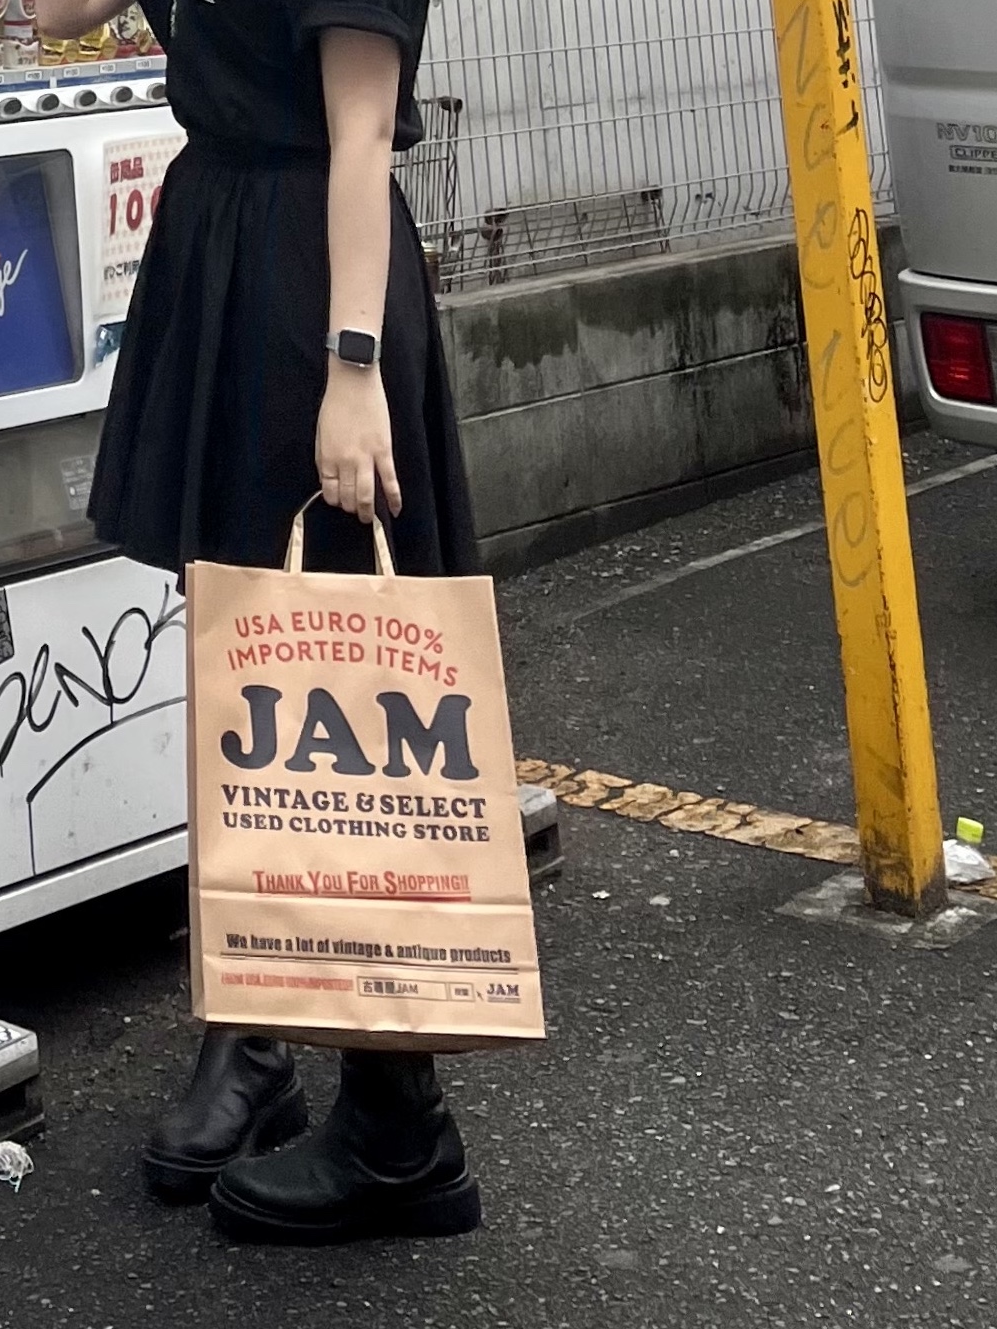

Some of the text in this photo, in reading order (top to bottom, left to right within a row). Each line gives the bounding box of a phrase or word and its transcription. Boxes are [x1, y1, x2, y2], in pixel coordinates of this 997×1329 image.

[234, 611, 445, 655] USA EURO 100%
[227, 640, 460, 688] IMPORTED ITEMS
[220, 684, 481, 782] JAM
[220, 784, 487, 820] VINTAGE & SELECT
[222, 811, 491, 843] USED CLOTHING STORE
[226, 933, 511, 964] We have a lot of vintage & antique products
[487, 983, 520, 998] JAM
